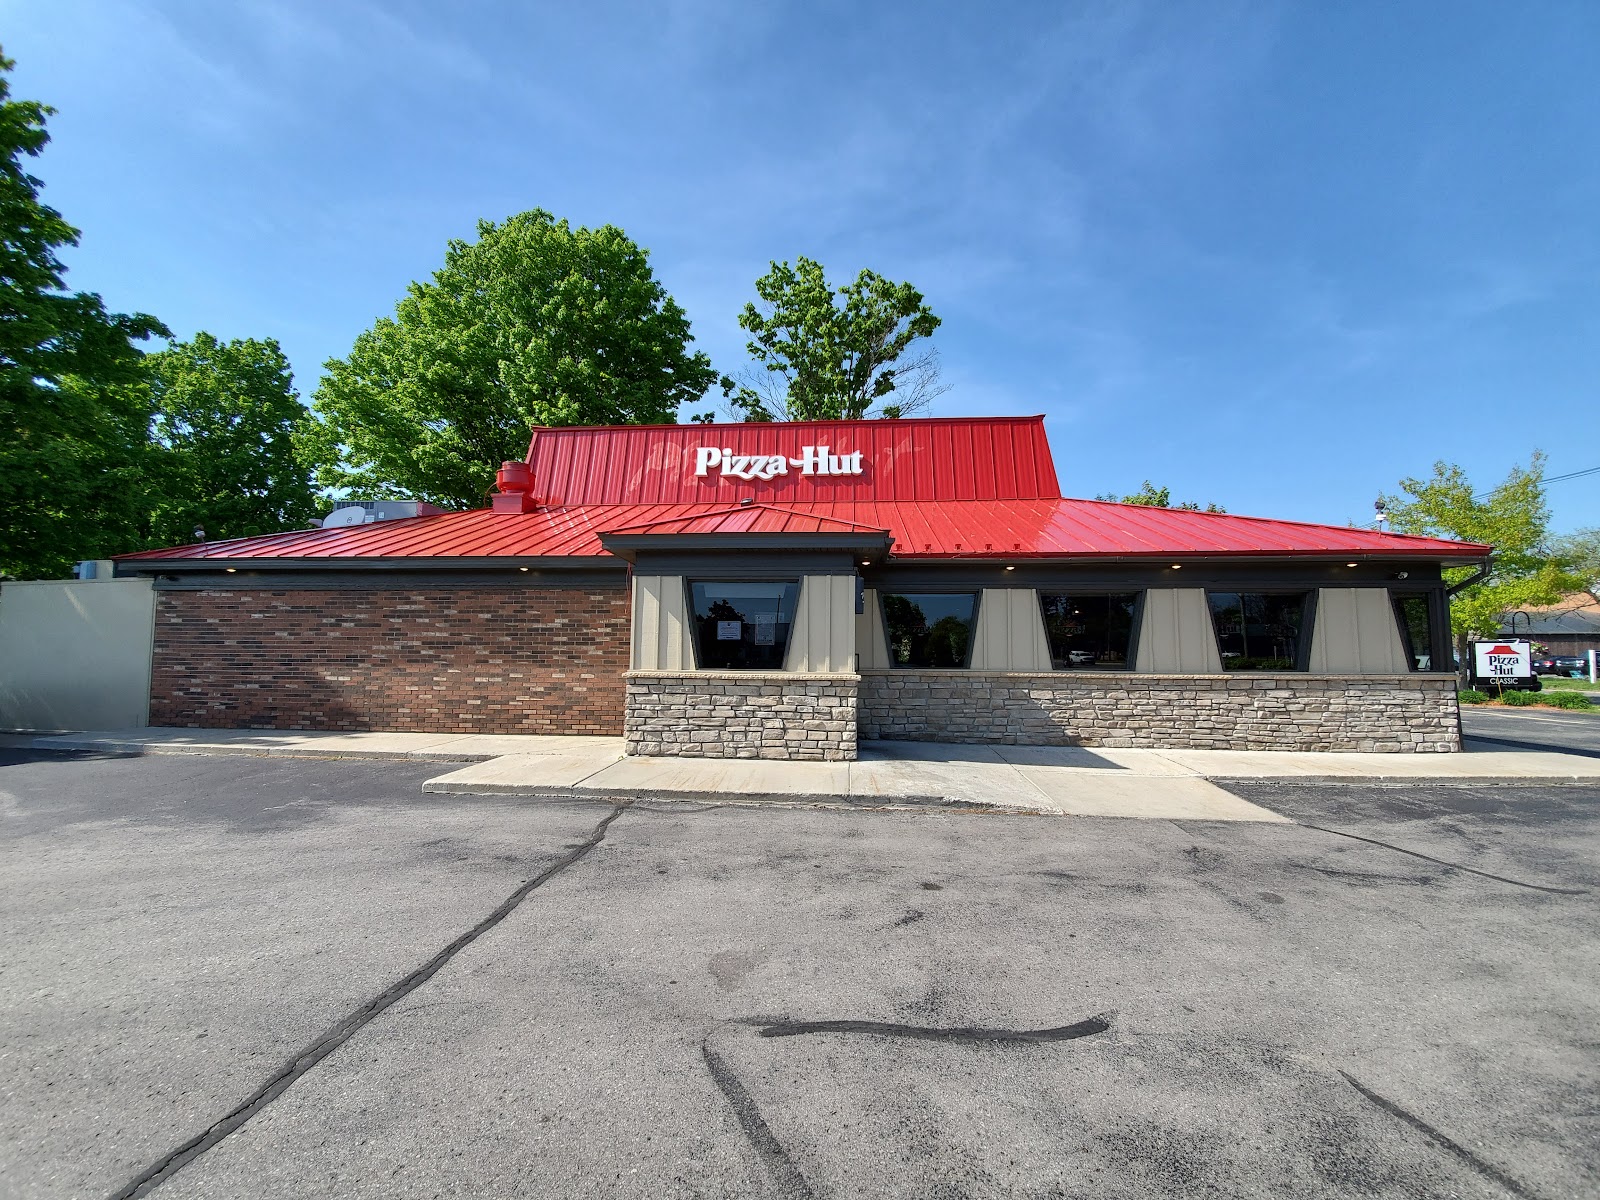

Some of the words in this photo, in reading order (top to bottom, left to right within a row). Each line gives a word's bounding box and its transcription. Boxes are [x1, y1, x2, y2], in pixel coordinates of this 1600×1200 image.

[695, 446, 788, 481] Pizza
[789, 446, 864, 477] Hut
[1489, 655, 1519, 666] Pizza
[1490, 665, 1514, 675] Hut
